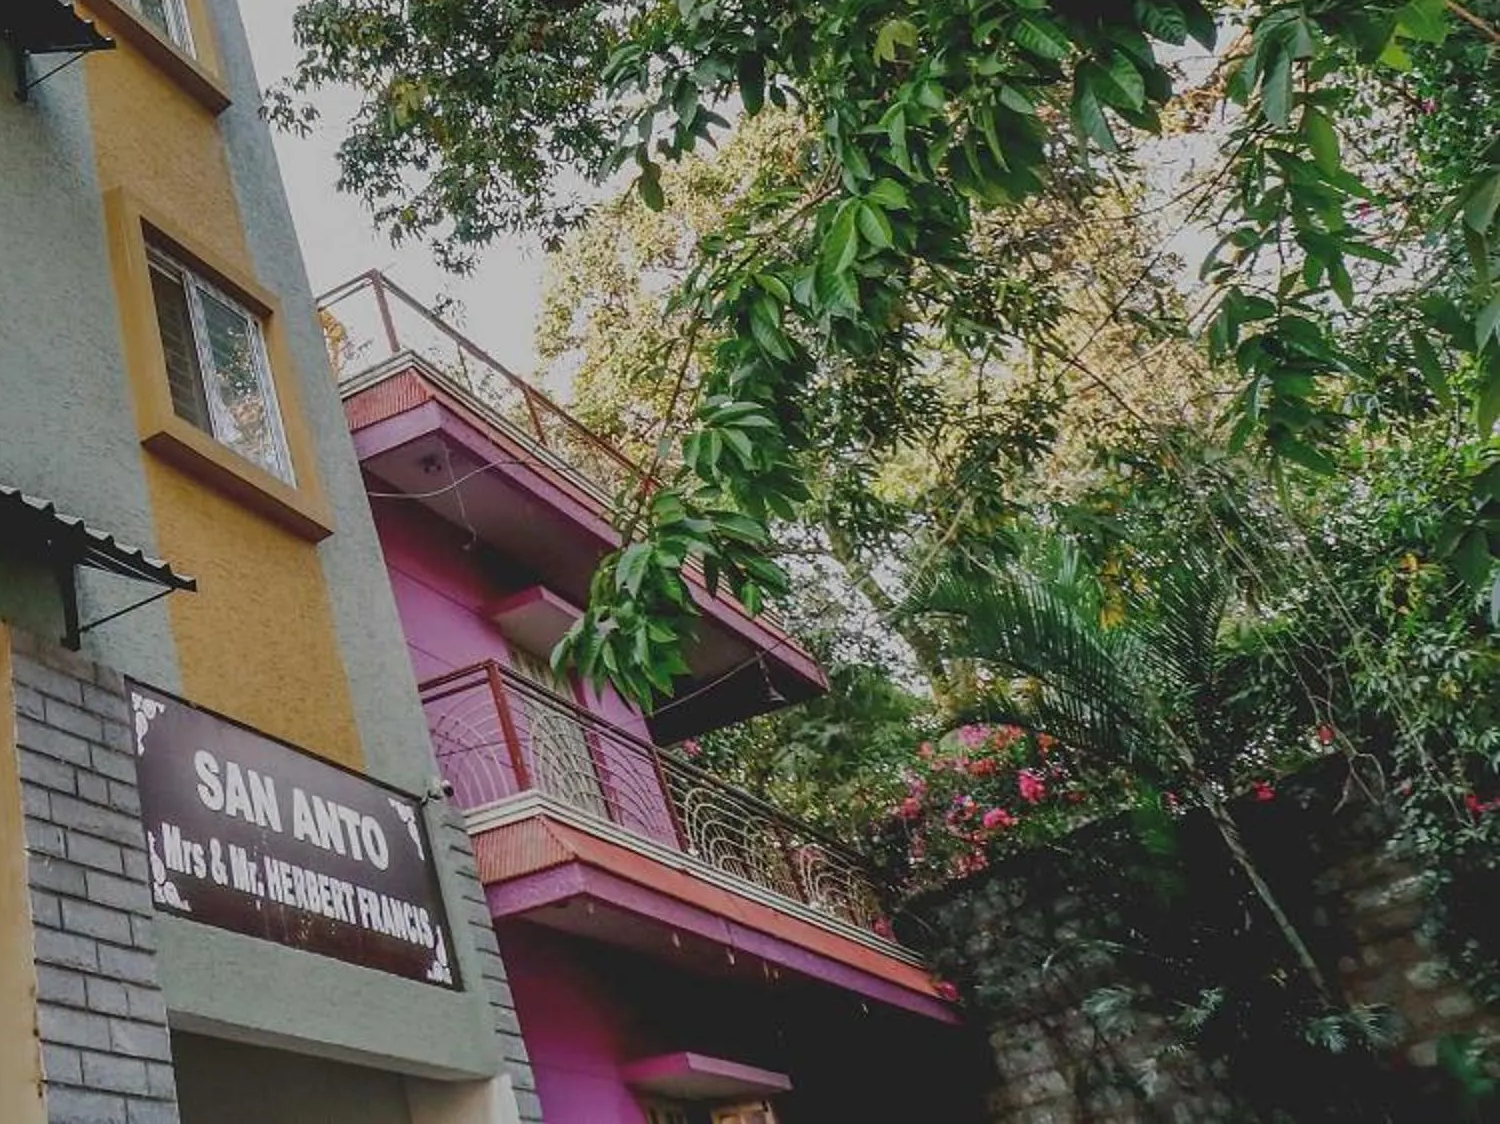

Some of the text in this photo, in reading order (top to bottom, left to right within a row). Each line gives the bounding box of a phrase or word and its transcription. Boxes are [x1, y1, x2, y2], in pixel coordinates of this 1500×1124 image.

[194, 750, 389, 871] SAN ANTO
[161, 822, 207, 879] Mrs
[210, 837, 229, 886] &
[264, 855, 356, 925] HERBERT
[356, 885, 435, 949] FRANCIS
